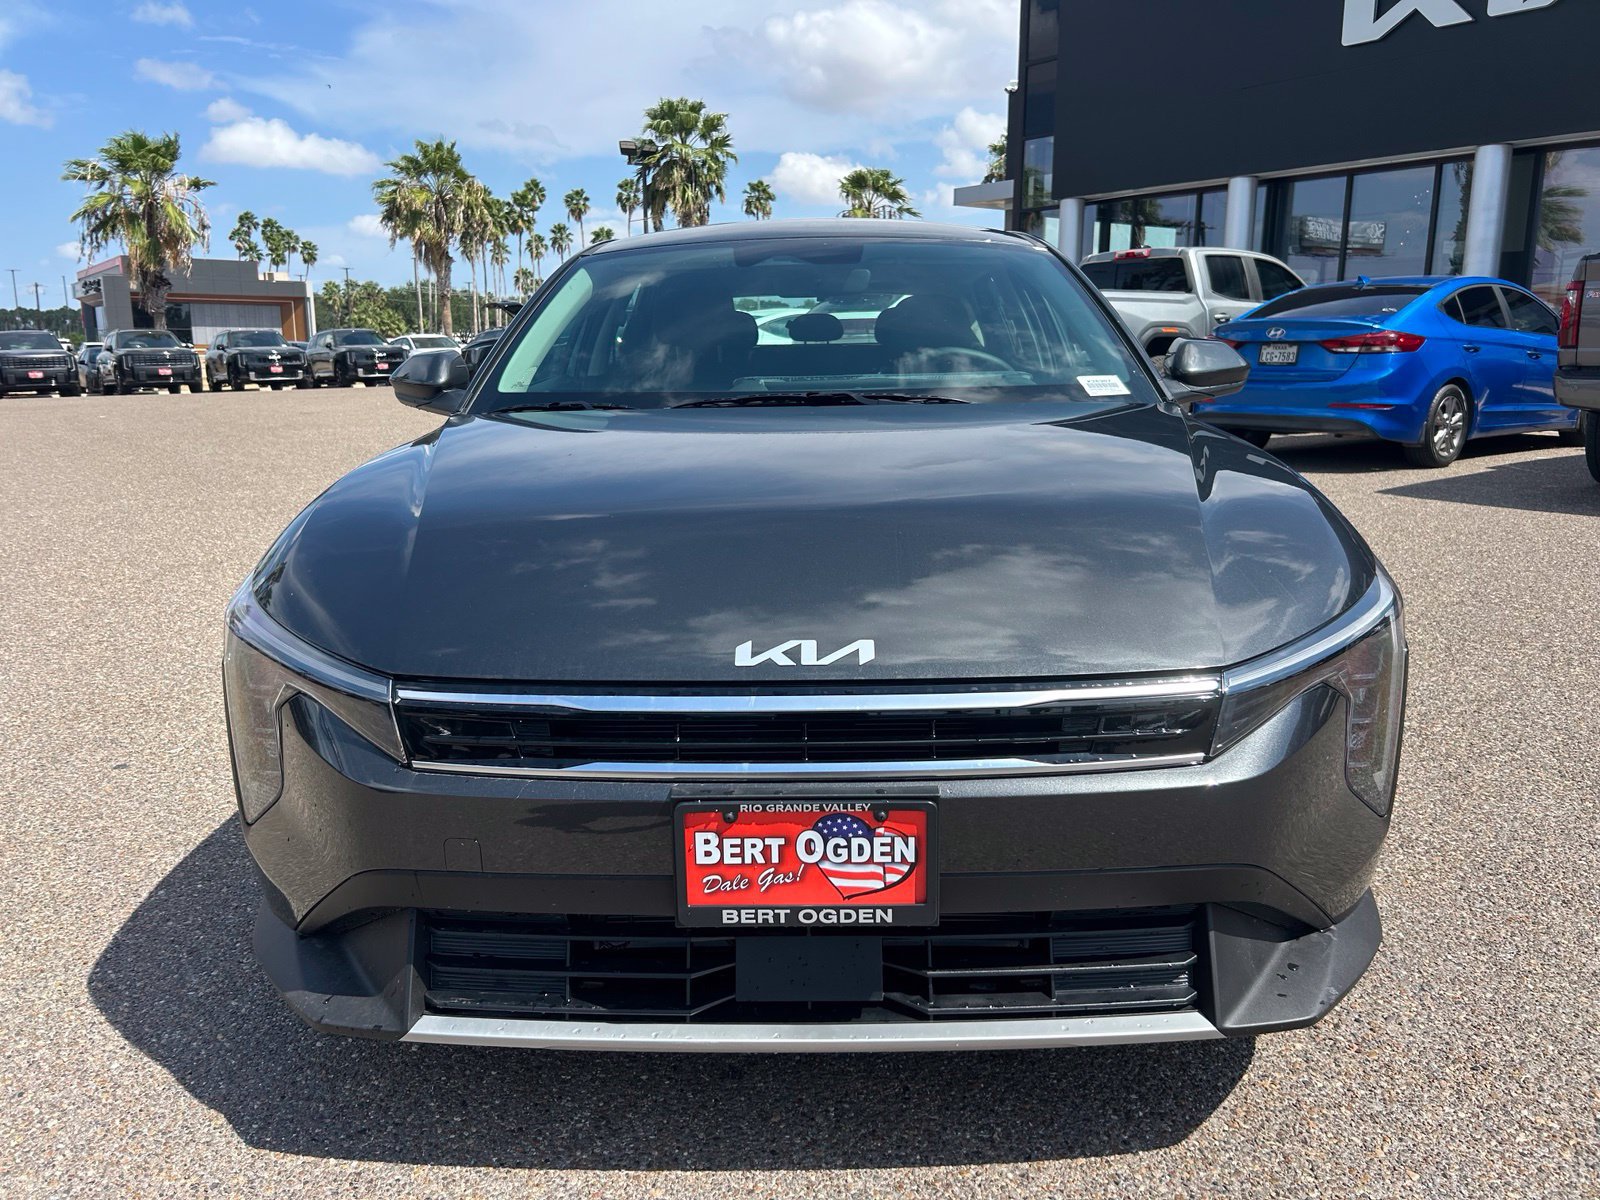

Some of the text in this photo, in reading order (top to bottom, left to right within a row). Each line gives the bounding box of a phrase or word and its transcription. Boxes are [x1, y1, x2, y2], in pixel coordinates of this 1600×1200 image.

[734, 639, 875, 666] KIA
[740, 803, 871, 813] RIO GRANDE VALLEY
[694, 829, 916, 865] BERT OGDEN
[702, 863, 805, 894] Dale Gas!
[722, 908, 893, 924] BERT OGDEN
